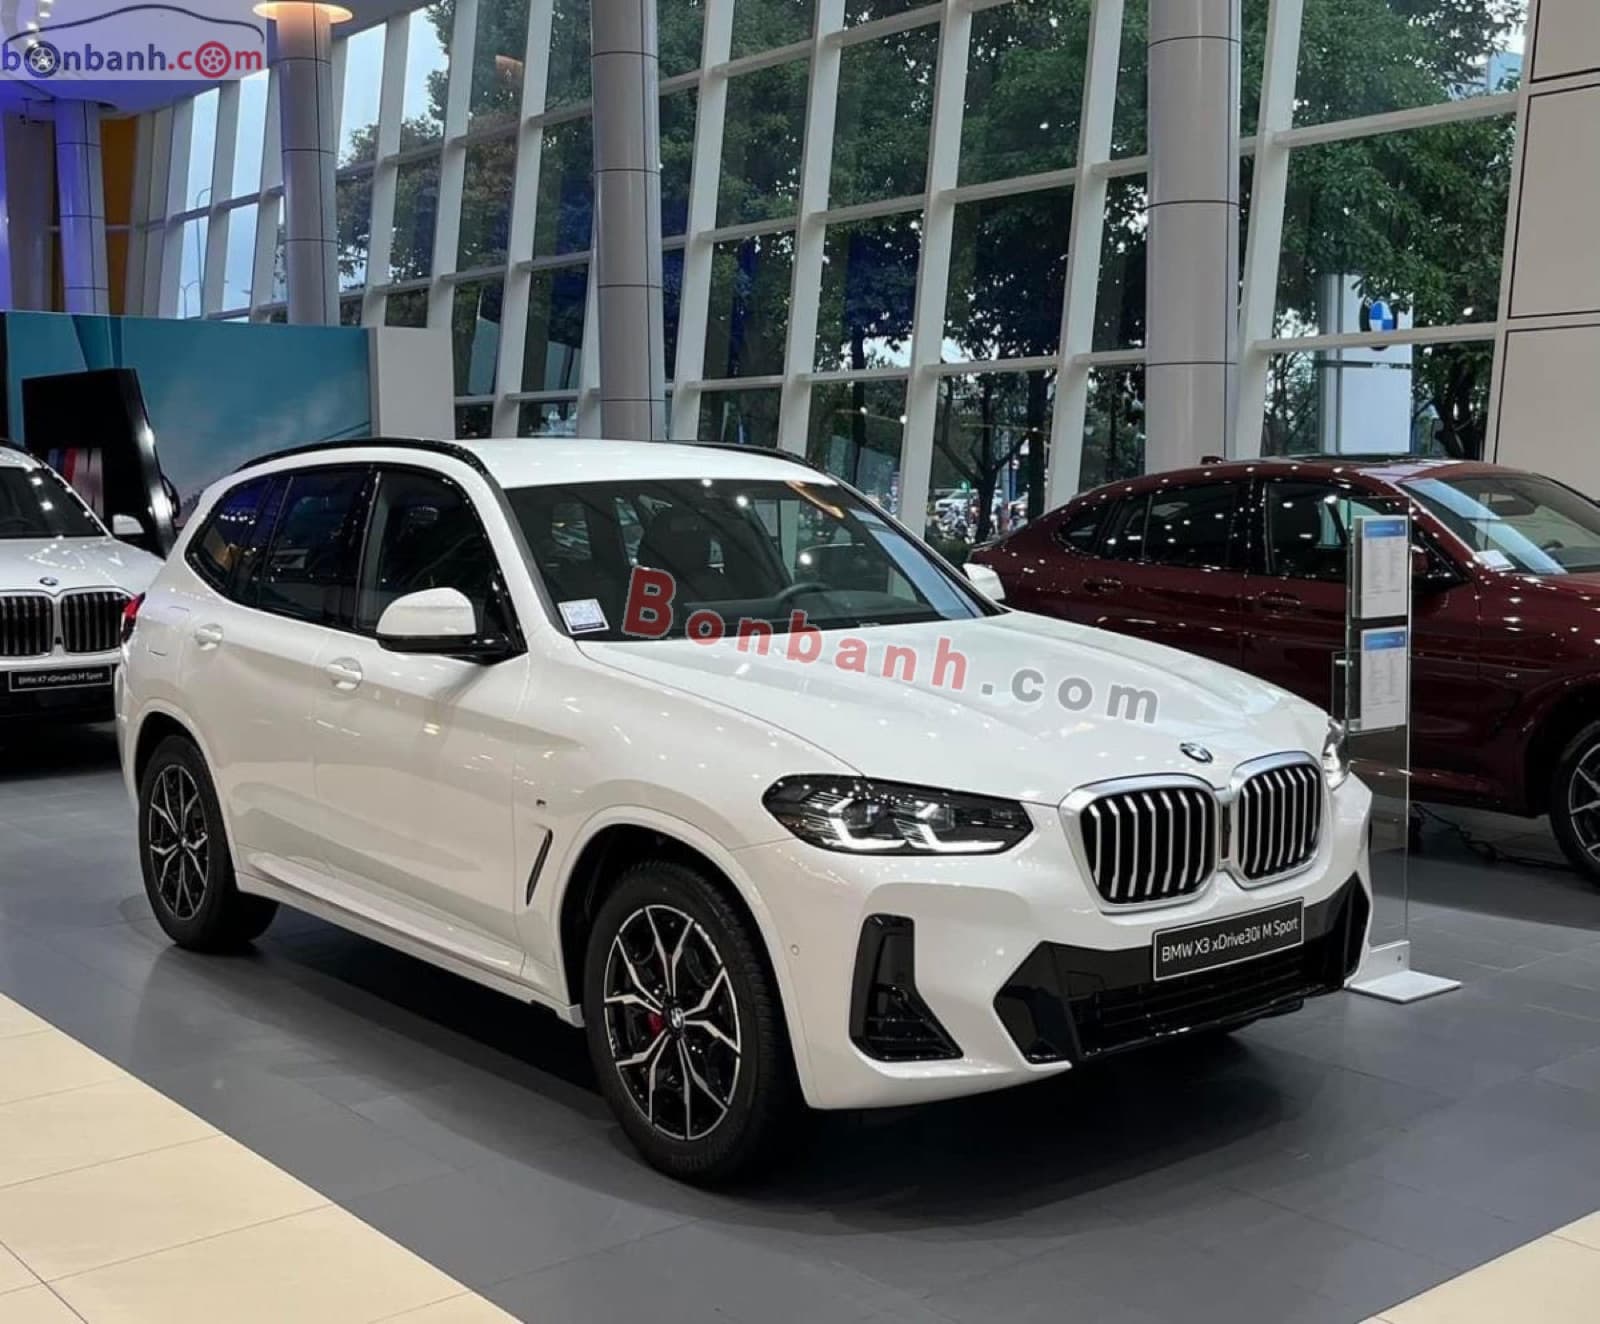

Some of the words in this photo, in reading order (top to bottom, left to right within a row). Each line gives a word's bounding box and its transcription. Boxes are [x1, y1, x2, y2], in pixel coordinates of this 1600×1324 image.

[1162, 940, 1193, 962] BMW
[1194, 936, 1210, 955] X3
[1211, 926, 1261, 951] xDrive30i
[1262, 922, 1272, 939] M
[1273, 917, 1299, 937] Sport
